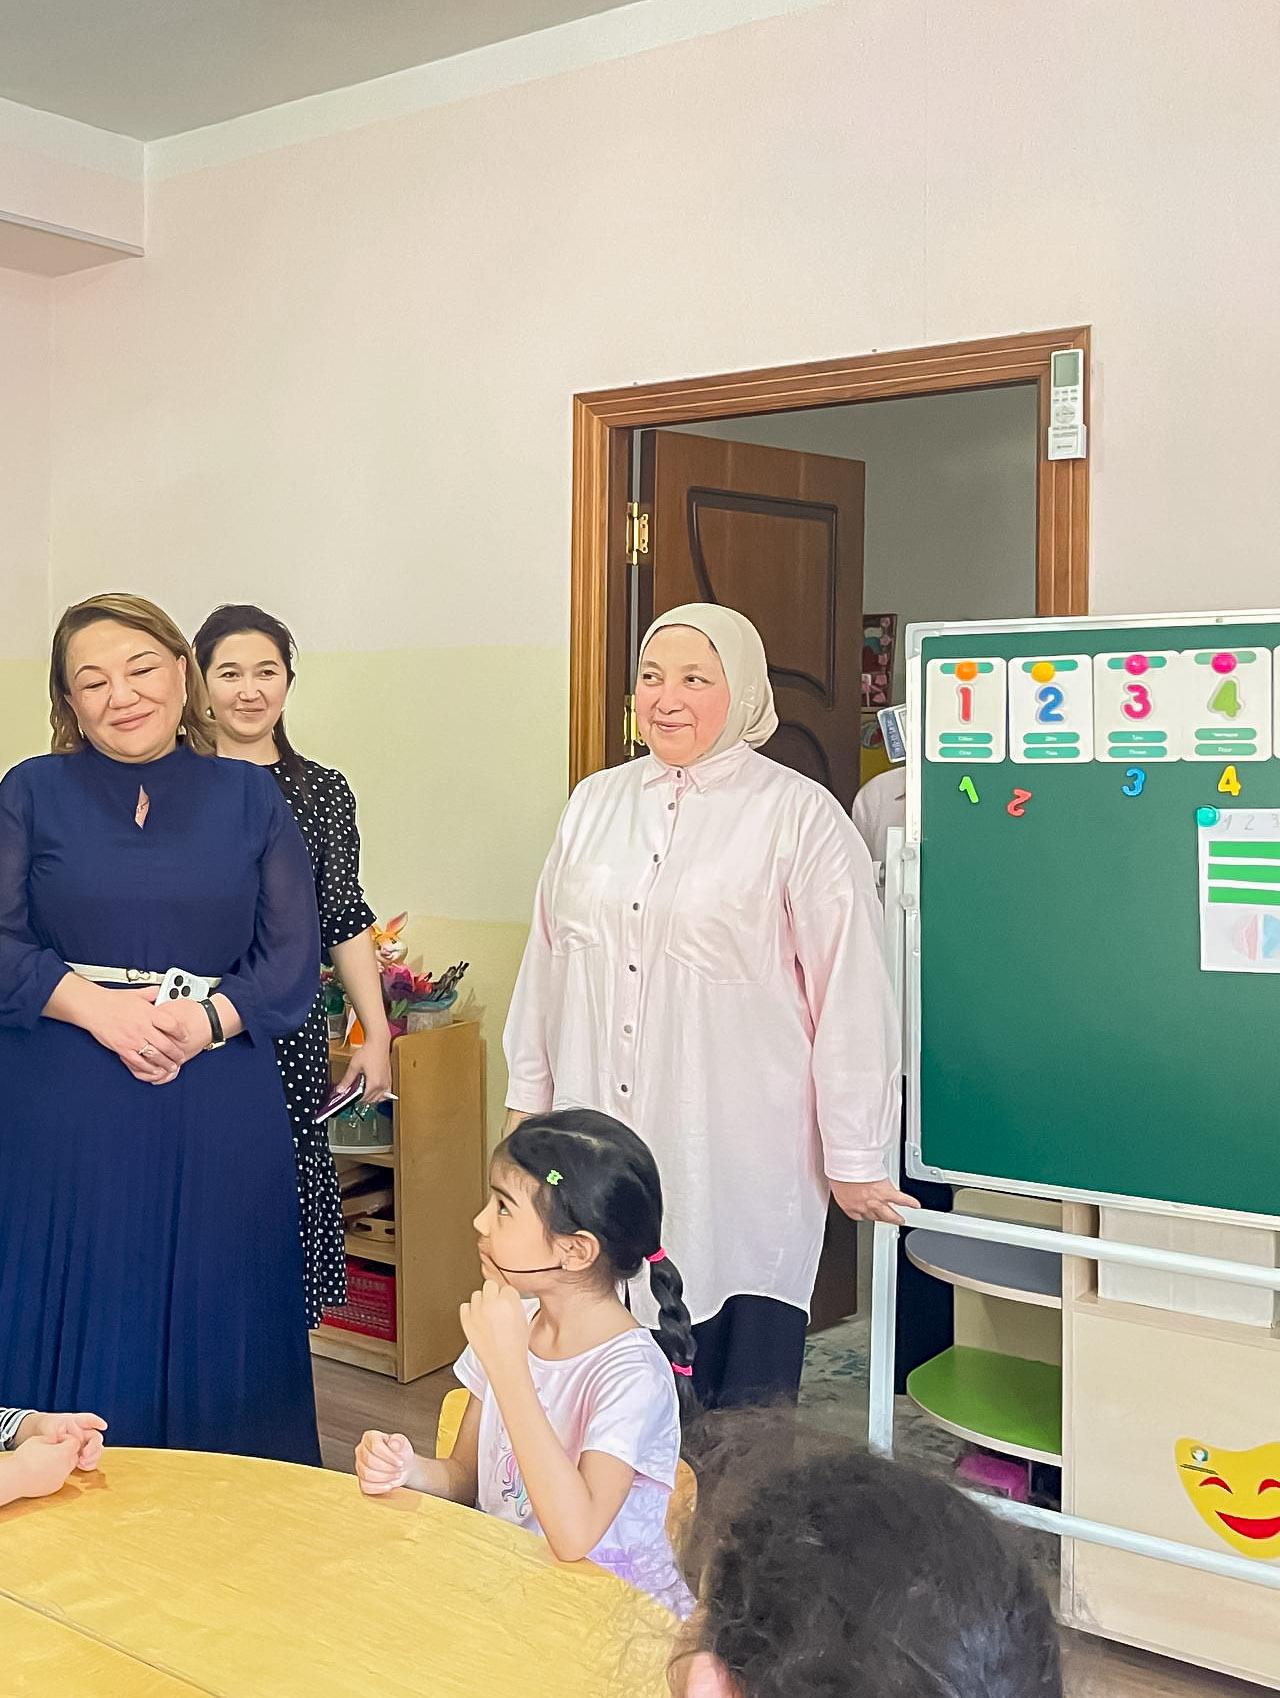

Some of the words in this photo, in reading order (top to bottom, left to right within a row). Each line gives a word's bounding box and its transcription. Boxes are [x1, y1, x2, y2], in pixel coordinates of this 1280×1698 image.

[959, 686, 972, 722] 1
[1039, 686, 1065, 722] 2
[1123, 684, 1152, 720] 3
[1211, 679, 1241, 718] 4
[1122, 768, 1147, 797] 3
[1217, 765, 1242, 797] 4
